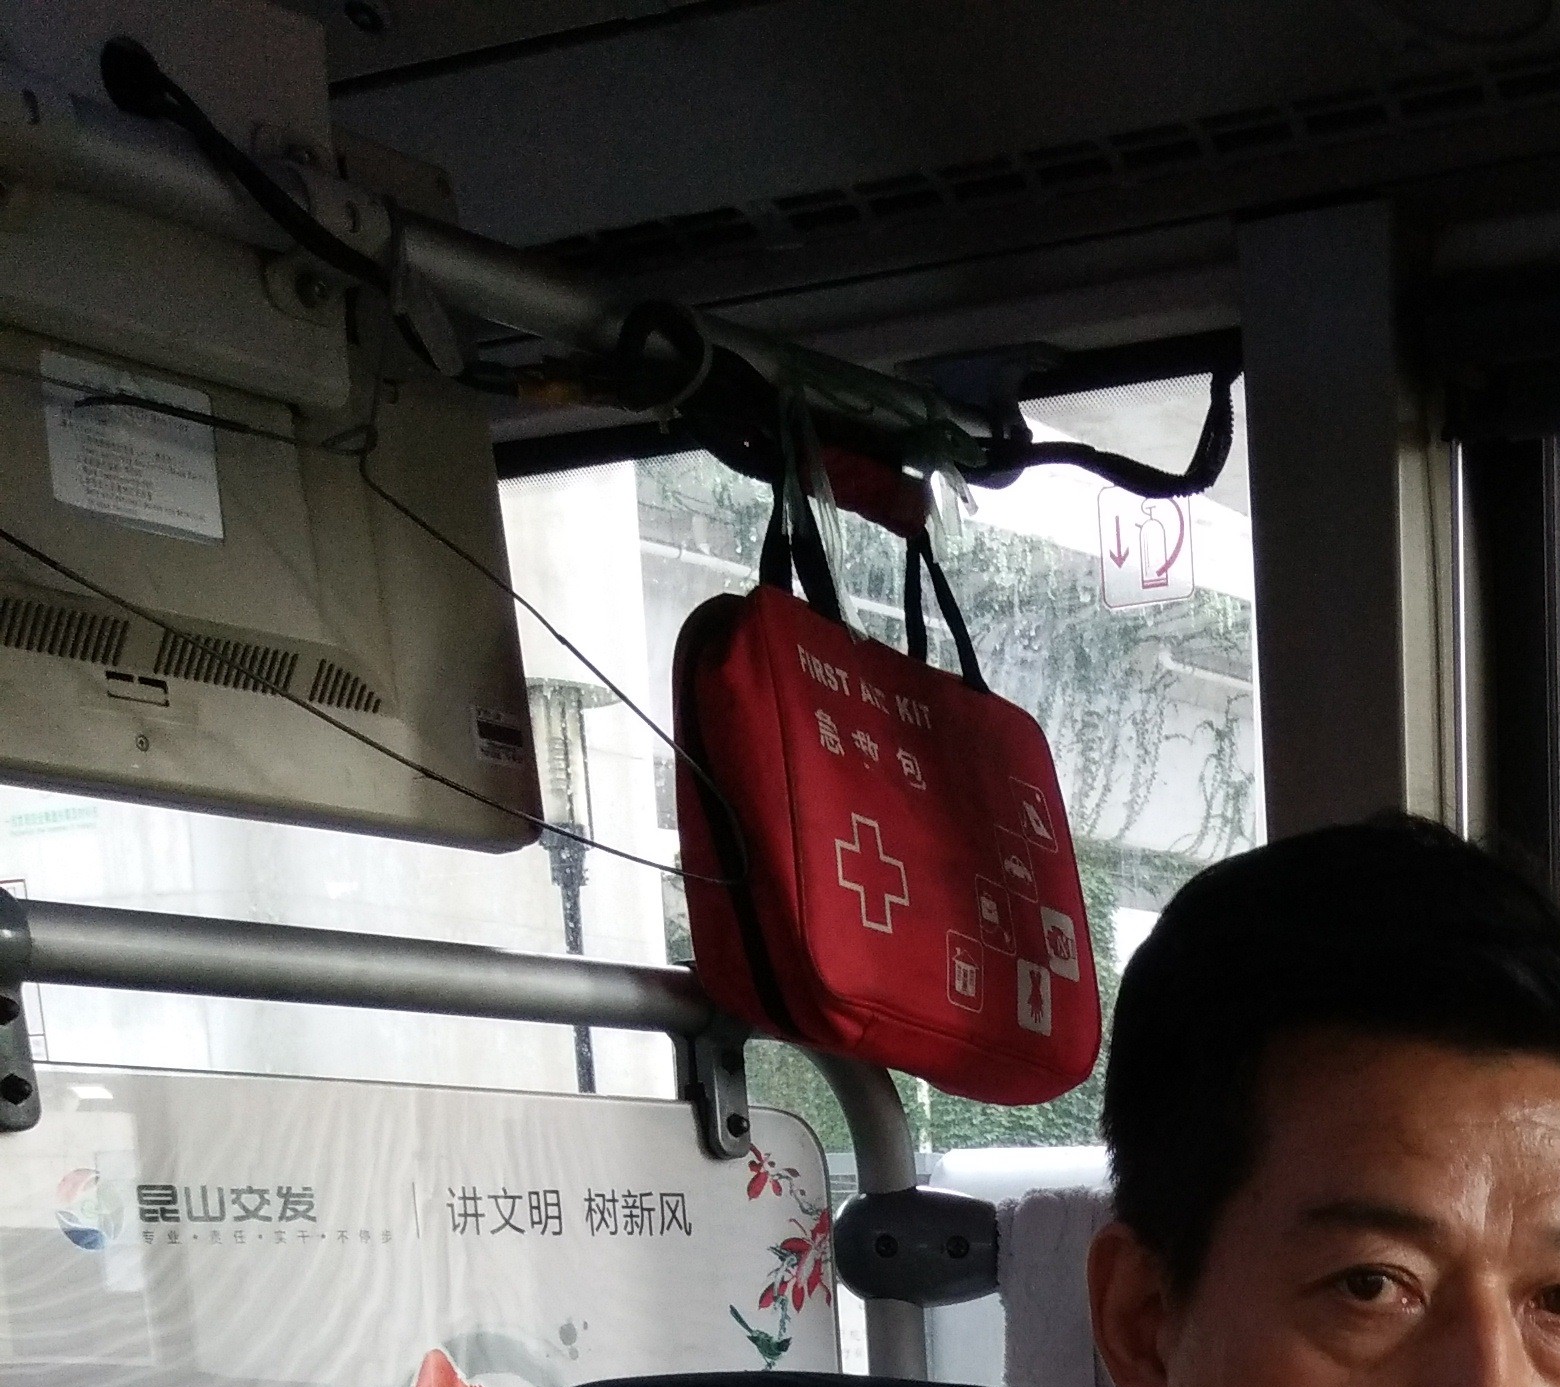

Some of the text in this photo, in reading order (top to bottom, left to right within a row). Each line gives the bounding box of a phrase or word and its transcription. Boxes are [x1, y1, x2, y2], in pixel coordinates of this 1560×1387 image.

[797, 643, 850, 696] FIRST
[896, 694, 932, 731] KIT
[814, 708, 927, 791] 急救包
[137, 1184, 317, 1222] 昆山交发
[446, 1186, 692, 1237] 讲文明 树新风
